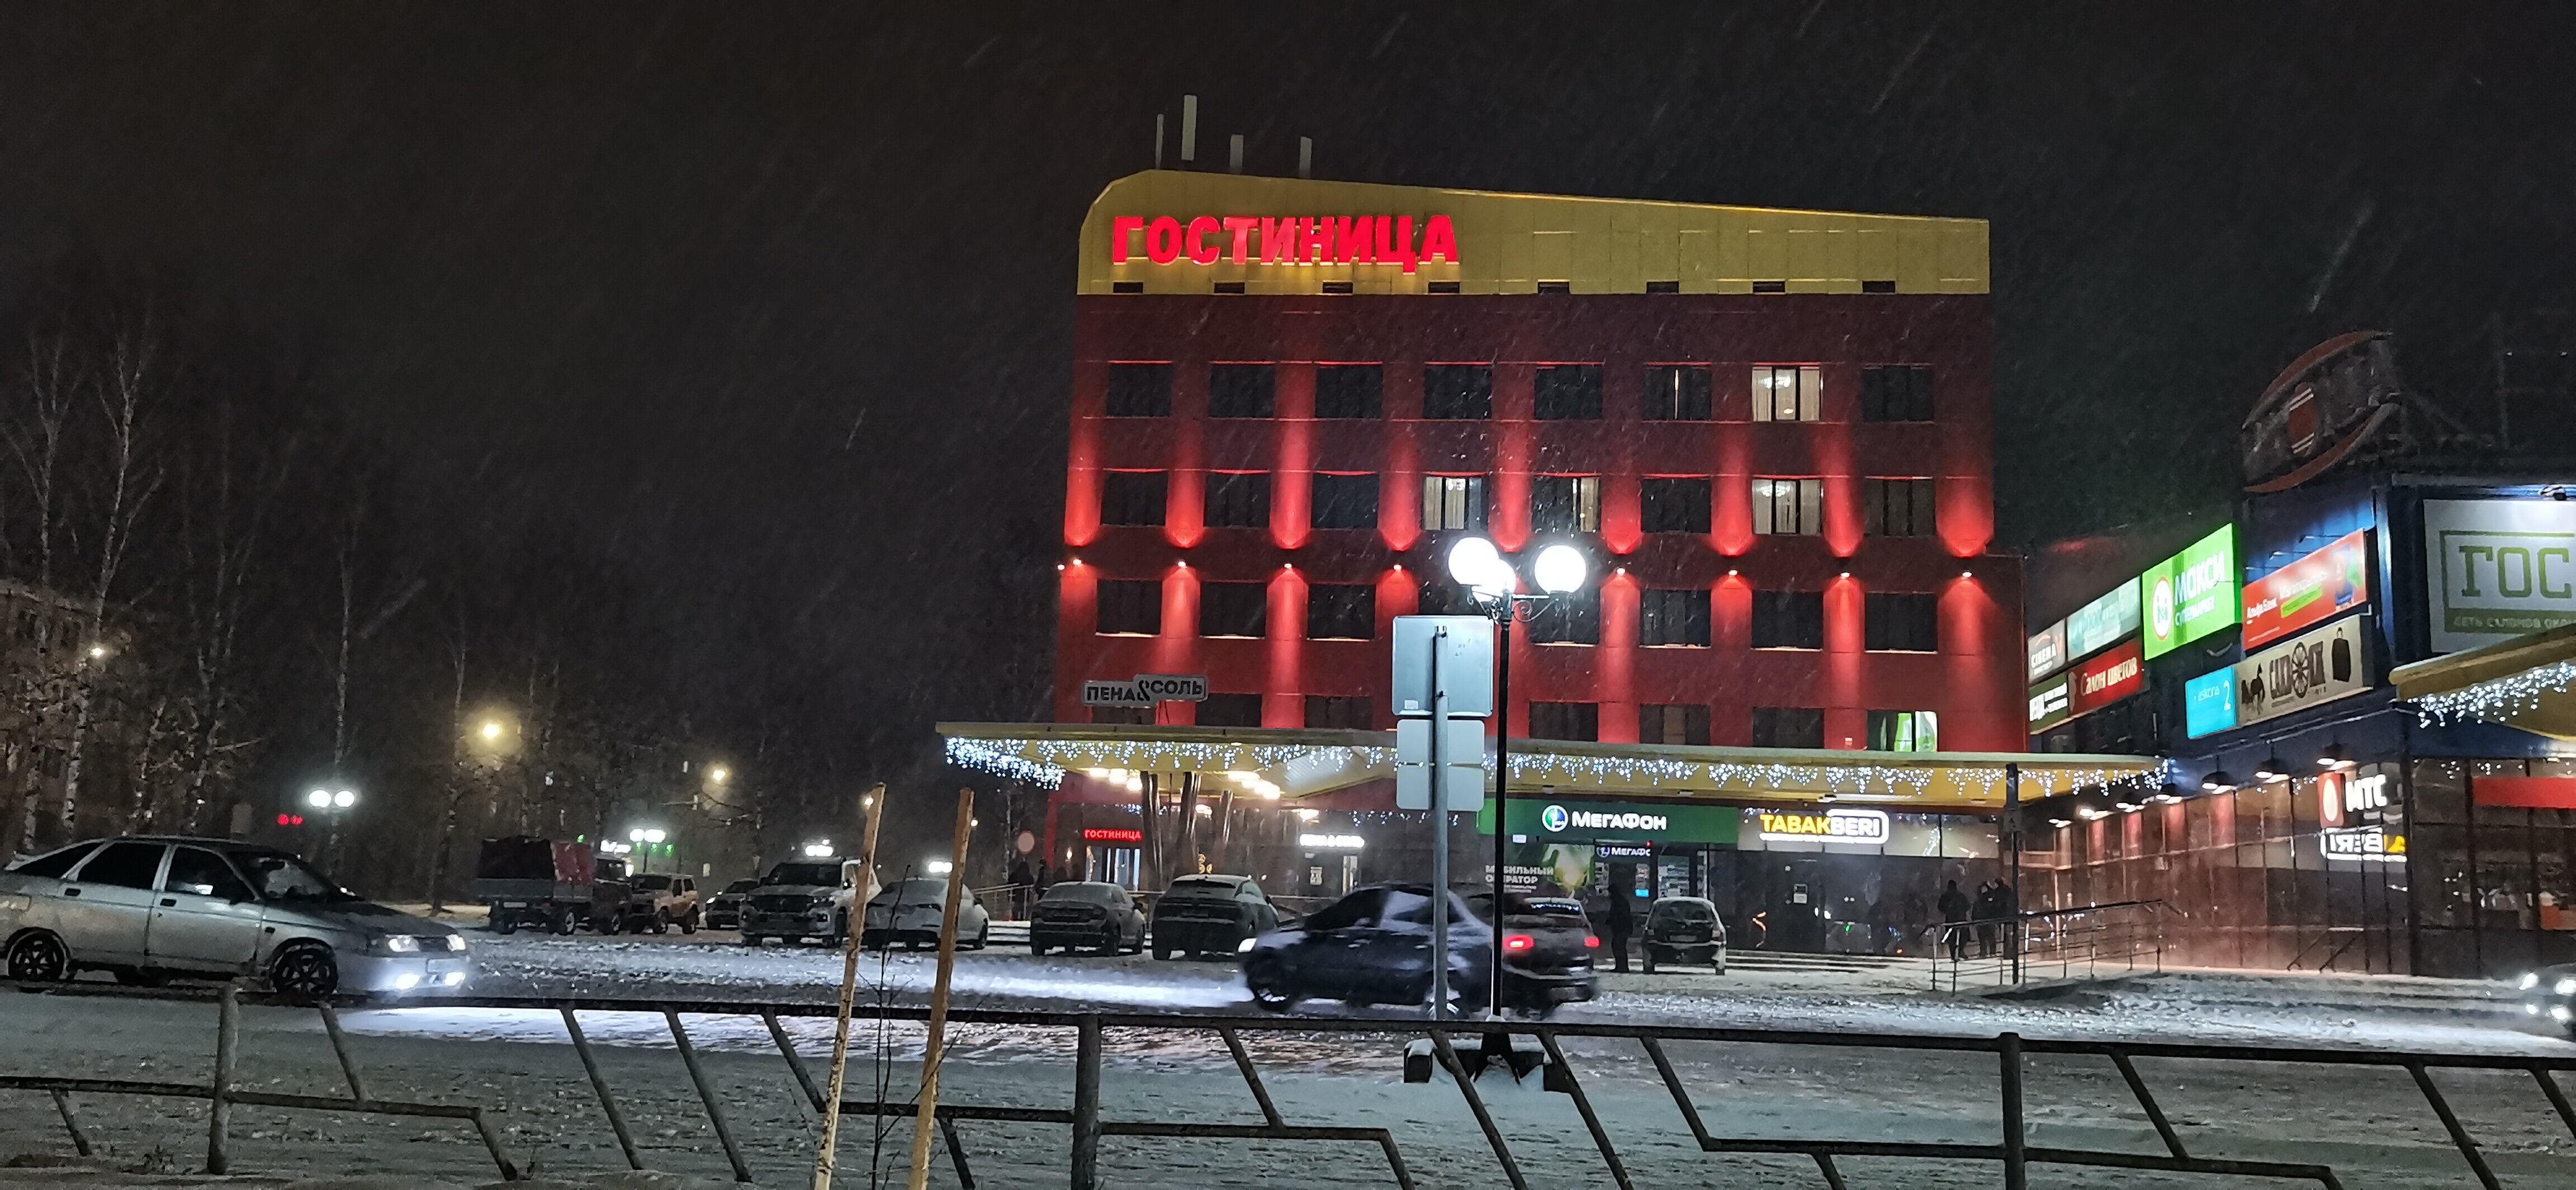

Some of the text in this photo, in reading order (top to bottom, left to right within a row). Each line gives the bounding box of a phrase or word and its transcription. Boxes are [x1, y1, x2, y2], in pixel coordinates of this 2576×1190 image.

[1112, 215, 1460, 275] ГОСТИНИЦА
[2459, 546, 2572, 598] ГОС
[2345, 774, 2388, 812] МТС
[1084, 829, 1142, 842] ГОСТИНИЦА
[1760, 814, 1880, 837] TABAKBERI
[1485, 864, 1554, 876] МБИЛЬНЫЙ
[1485, 874, 1538, 884] ОРАТОР
